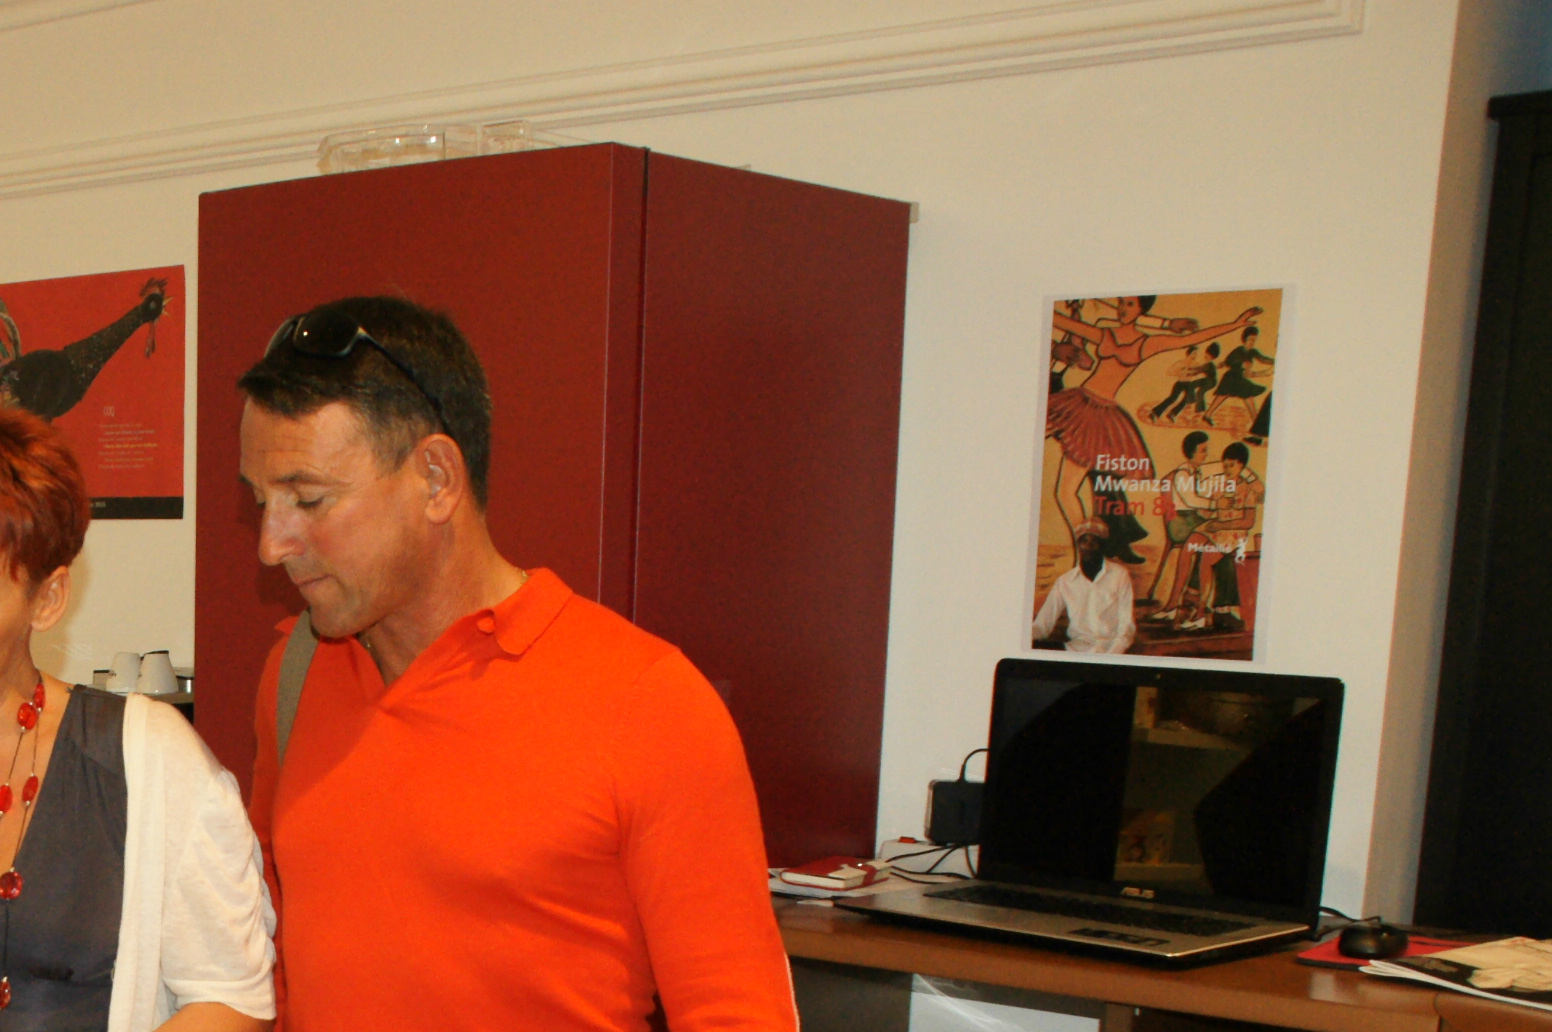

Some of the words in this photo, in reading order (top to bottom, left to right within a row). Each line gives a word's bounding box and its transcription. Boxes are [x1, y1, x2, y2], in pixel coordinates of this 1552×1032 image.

[1095, 454, 1150, 471] Fiston
[1094, 475, 1171, 492] Mwanza
[1177, 475, 1236, 498] Mujila
[1095, 496, 1145, 515] Tram
[1120, 886, 1155, 899] ASUS
